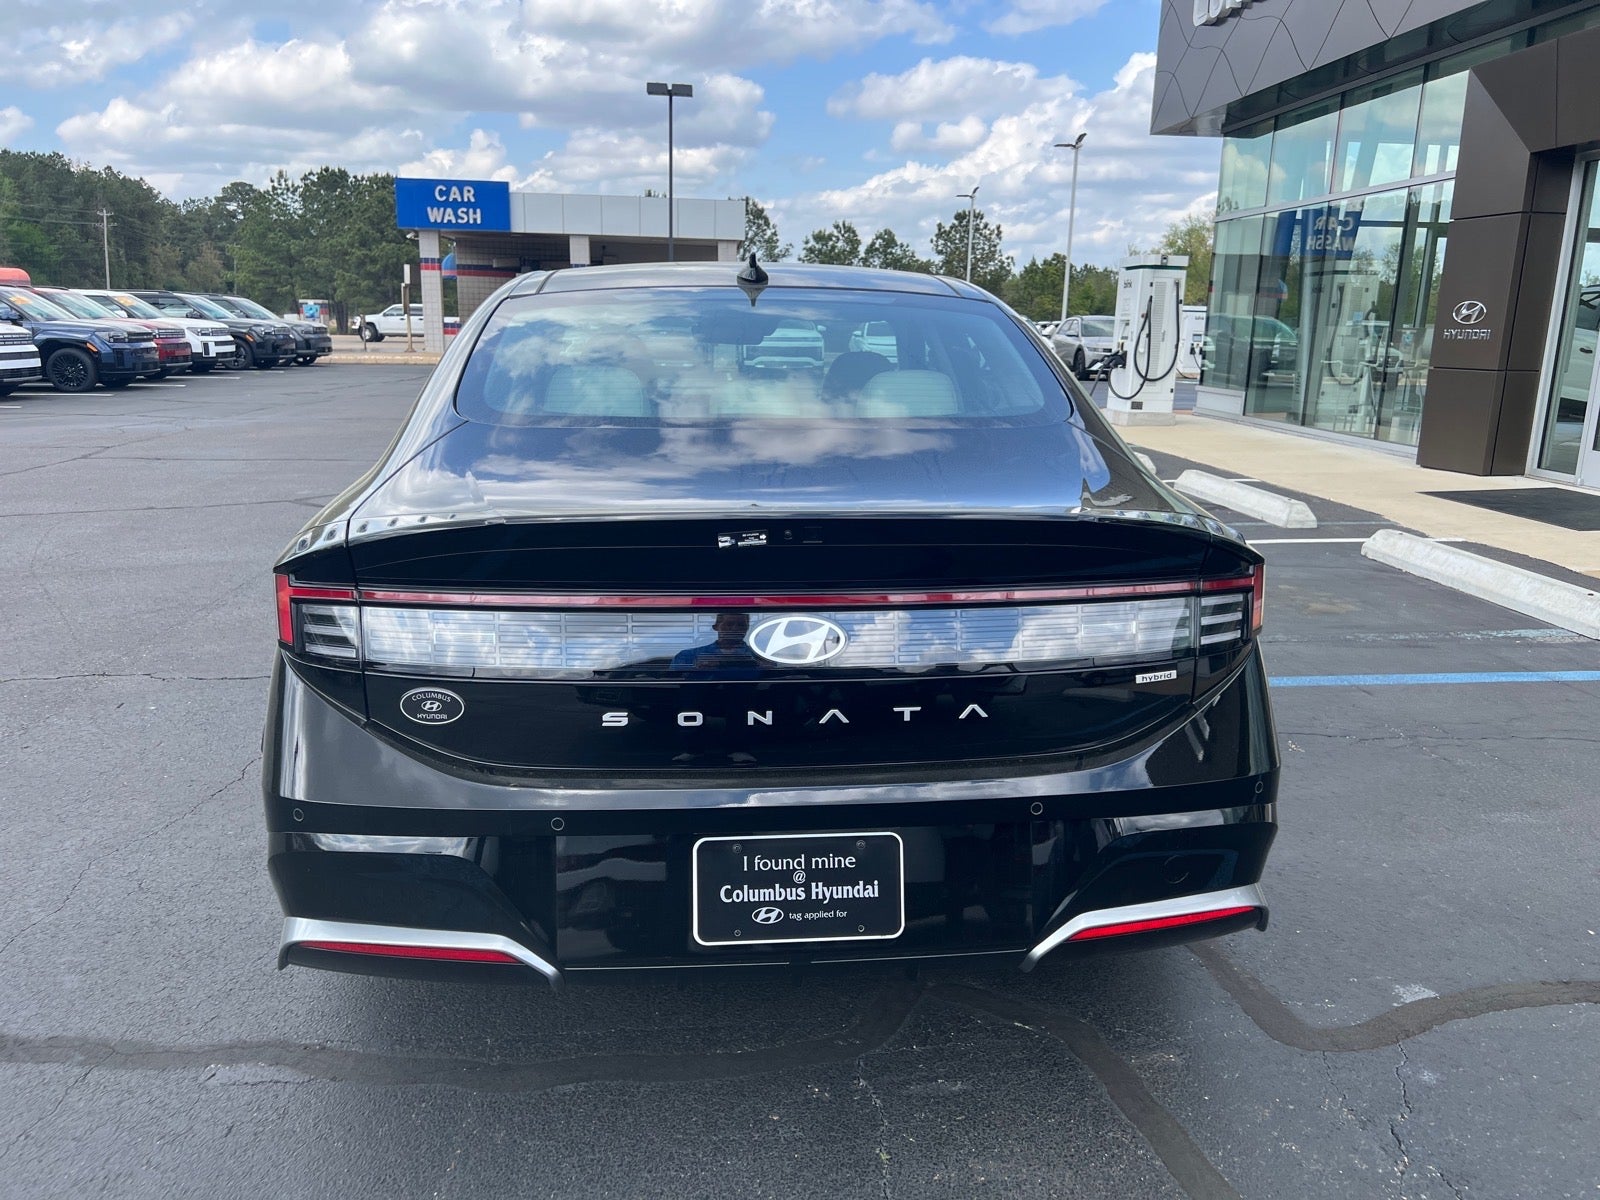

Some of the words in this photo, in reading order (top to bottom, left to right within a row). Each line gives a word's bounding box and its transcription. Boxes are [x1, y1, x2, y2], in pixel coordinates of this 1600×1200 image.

[434, 185, 475, 202] CAR
[427, 206, 482, 224] WASH
[1443, 329, 1491, 340] HYUNDAI
[1141, 672, 1172, 682] hybrid
[411, 692, 452, 703] COLUMBUS
[601, 703, 989, 727] SONATA
[742, 855, 748, 872] I
[754, 854, 805, 871] found
[811, 853, 856, 869] mine
[792, 870, 806, 884] @
[719, 883, 806, 903] Columbus
[811, 880, 879, 904] Hyundai
[789, 910, 802, 920] tag
[804, 909, 834, 919] applied
[836, 909, 847, 918] for
